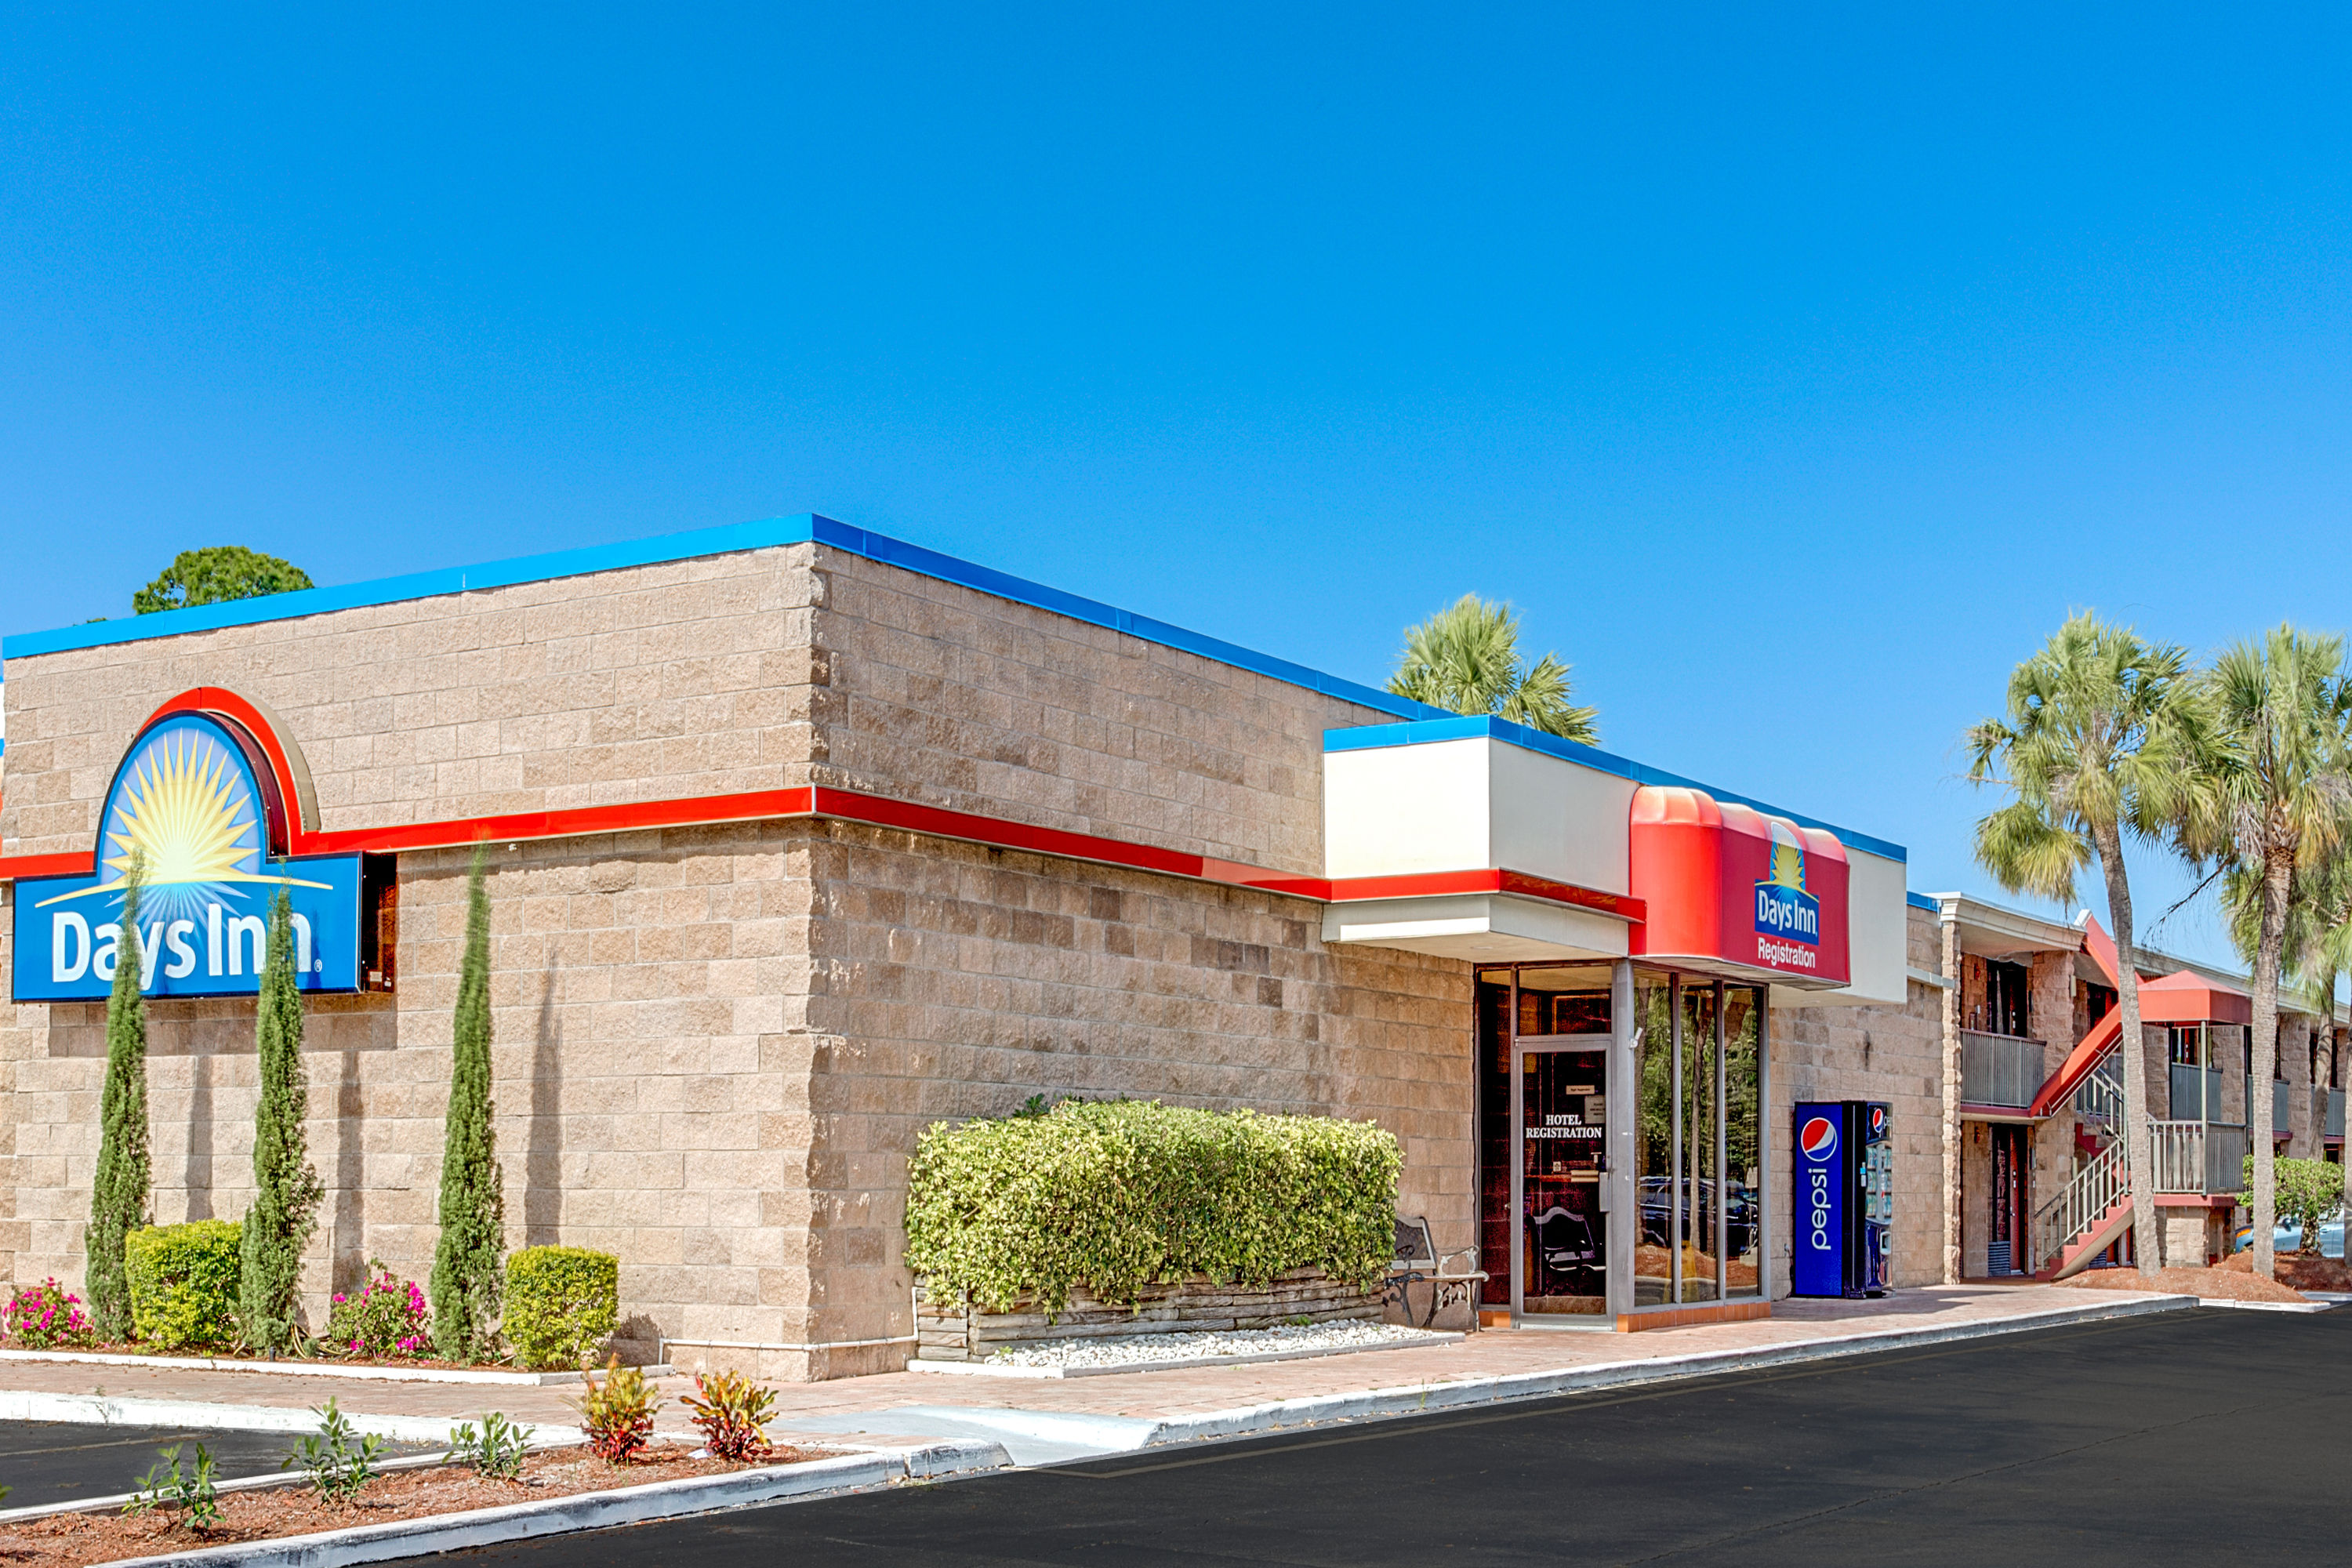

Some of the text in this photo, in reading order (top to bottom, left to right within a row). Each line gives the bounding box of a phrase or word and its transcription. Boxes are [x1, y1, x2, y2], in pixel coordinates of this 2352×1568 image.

[1759, 890, 1816, 935] Days Inn
[53, 911, 196, 991] Days
[1758, 937, 1816, 968] Registration
[1526, 1127, 1602, 1138] REGISTRATION
[1545, 1114, 1582, 1126] HOTEL
[1808, 1167, 1831, 1250] pepsi
